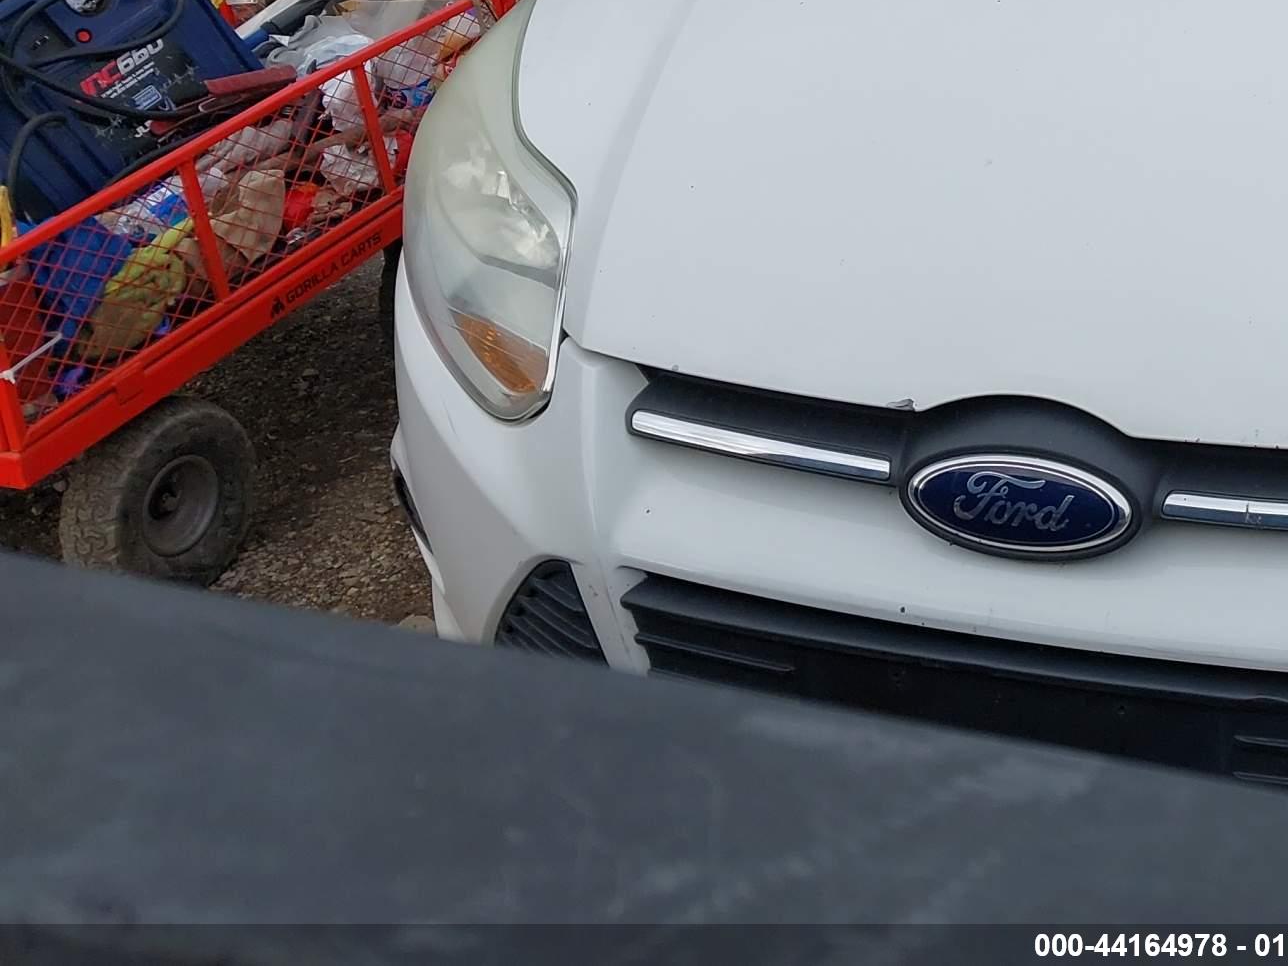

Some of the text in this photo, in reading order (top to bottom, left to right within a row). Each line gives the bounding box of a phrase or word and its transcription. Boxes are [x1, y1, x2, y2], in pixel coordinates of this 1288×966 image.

[286, 234, 383, 304] GORILLA CARTS
[953, 471, 1075, 532] Ford
